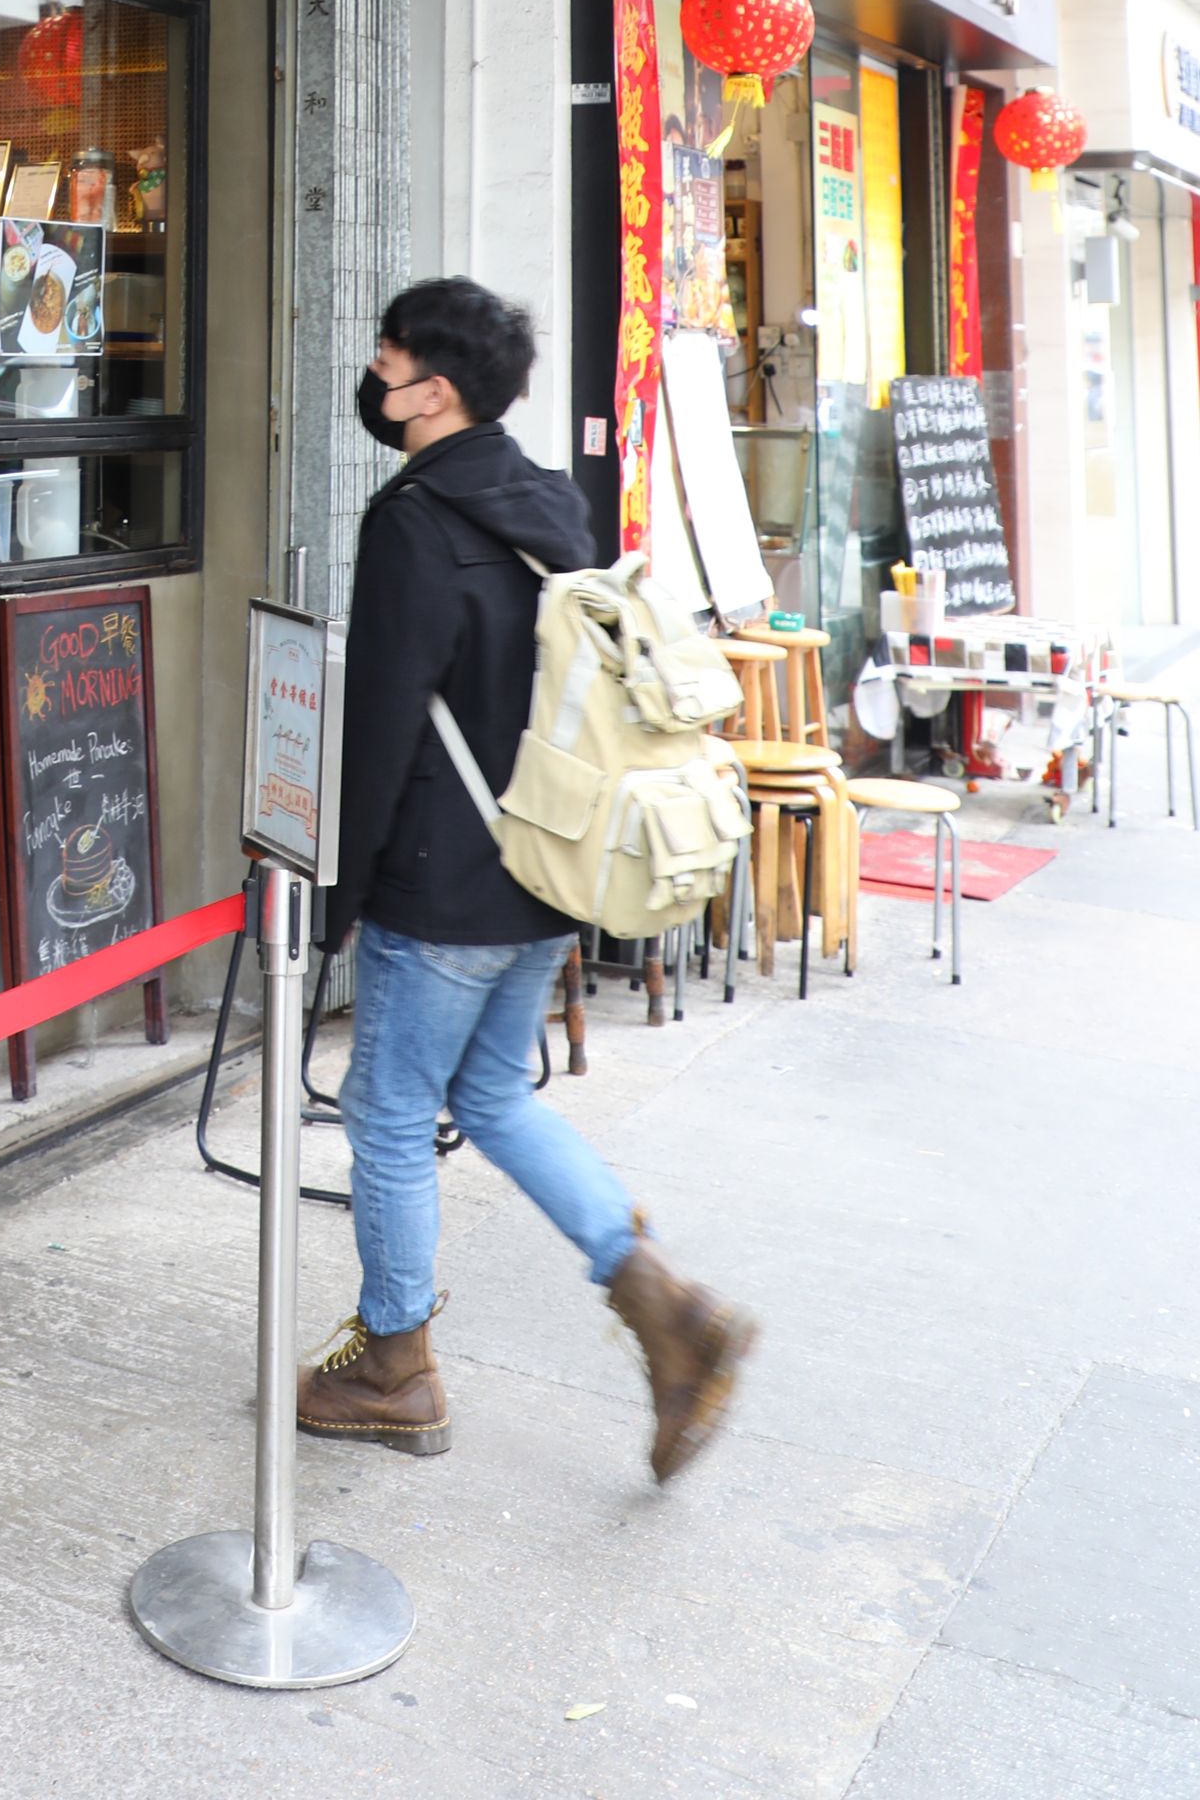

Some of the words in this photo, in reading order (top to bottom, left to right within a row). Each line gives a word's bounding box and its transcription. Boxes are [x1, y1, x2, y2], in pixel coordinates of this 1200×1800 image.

[40, 622, 100, 672] GOOD
[60, 663, 142, 716] MORNING
[28, 738, 85, 780] Homemade
